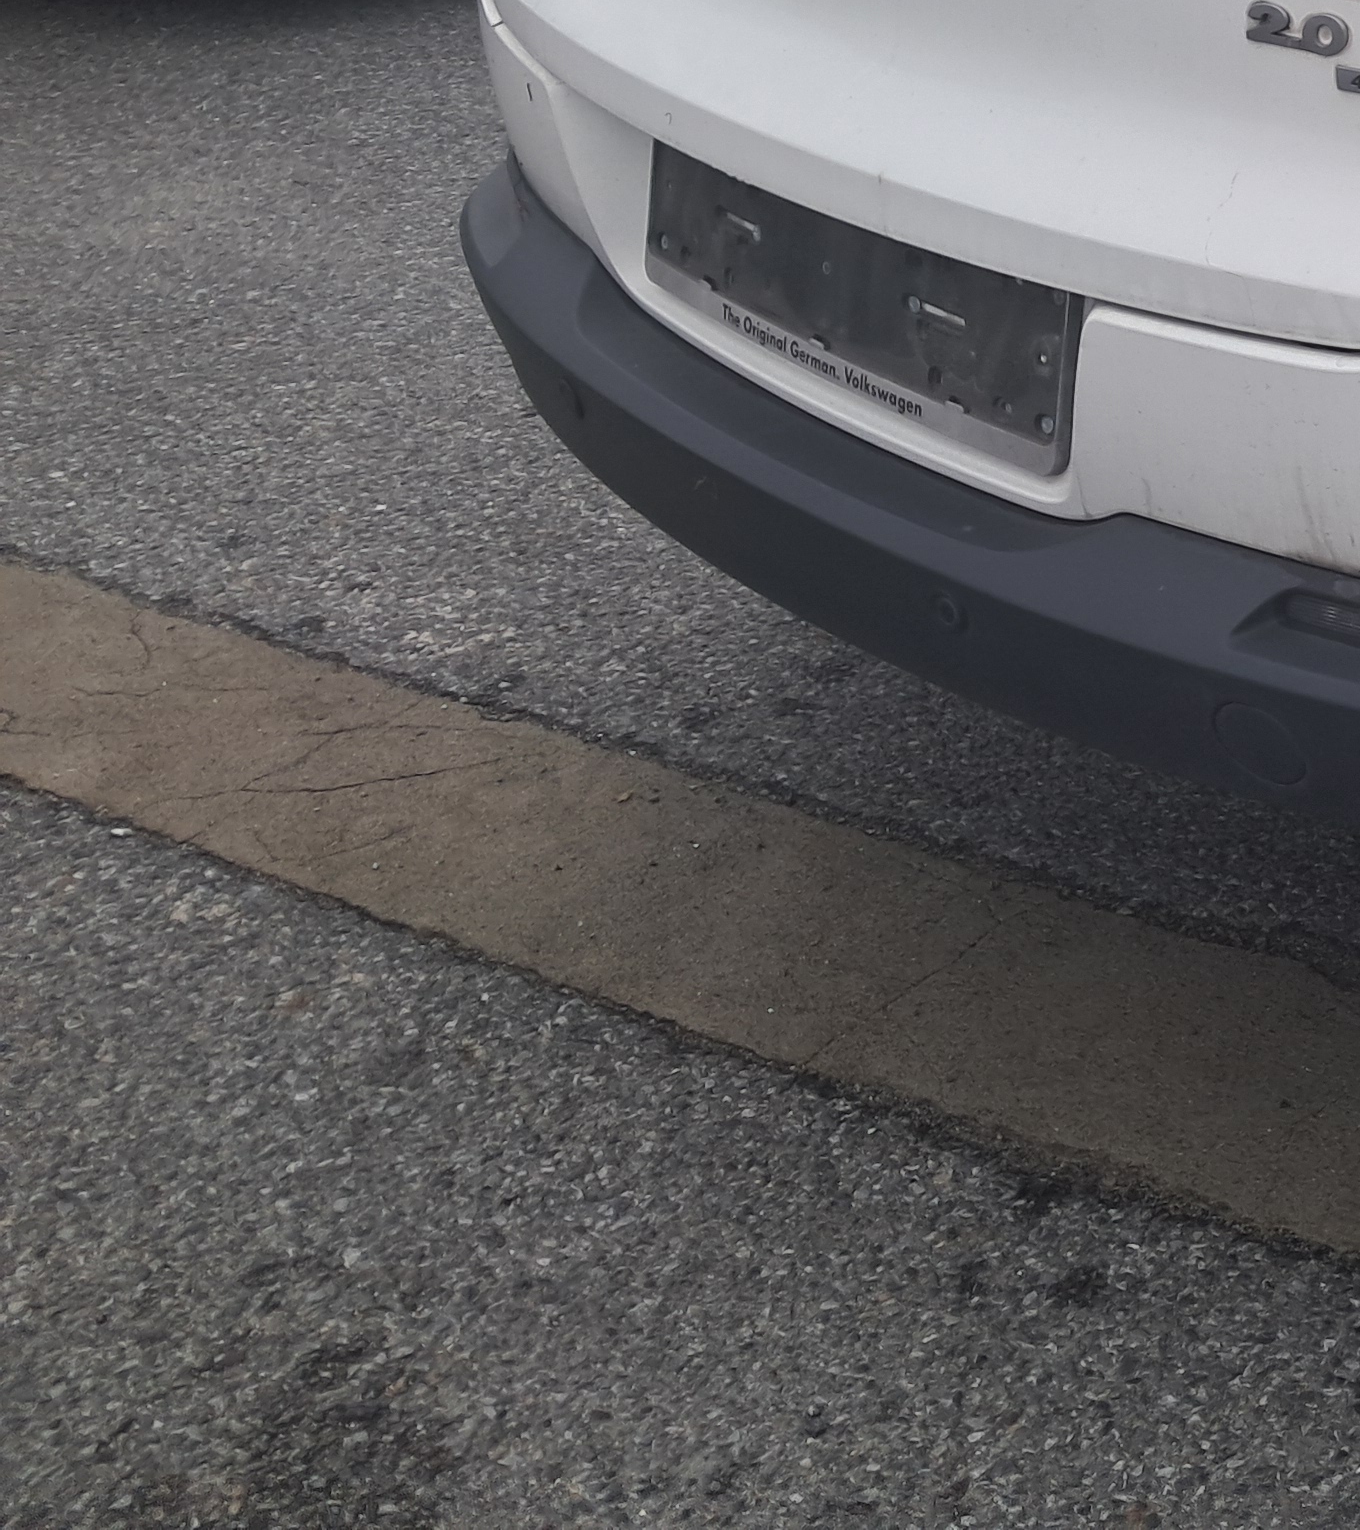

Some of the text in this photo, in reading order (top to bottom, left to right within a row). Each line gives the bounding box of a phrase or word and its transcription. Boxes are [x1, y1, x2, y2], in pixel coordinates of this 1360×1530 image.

[1246, 0, 1350, 58] 2.0
[721, 303, 741, 328] The
[743, 316, 787, 353] Original
[844, 365, 924, 418] Volkswagen
